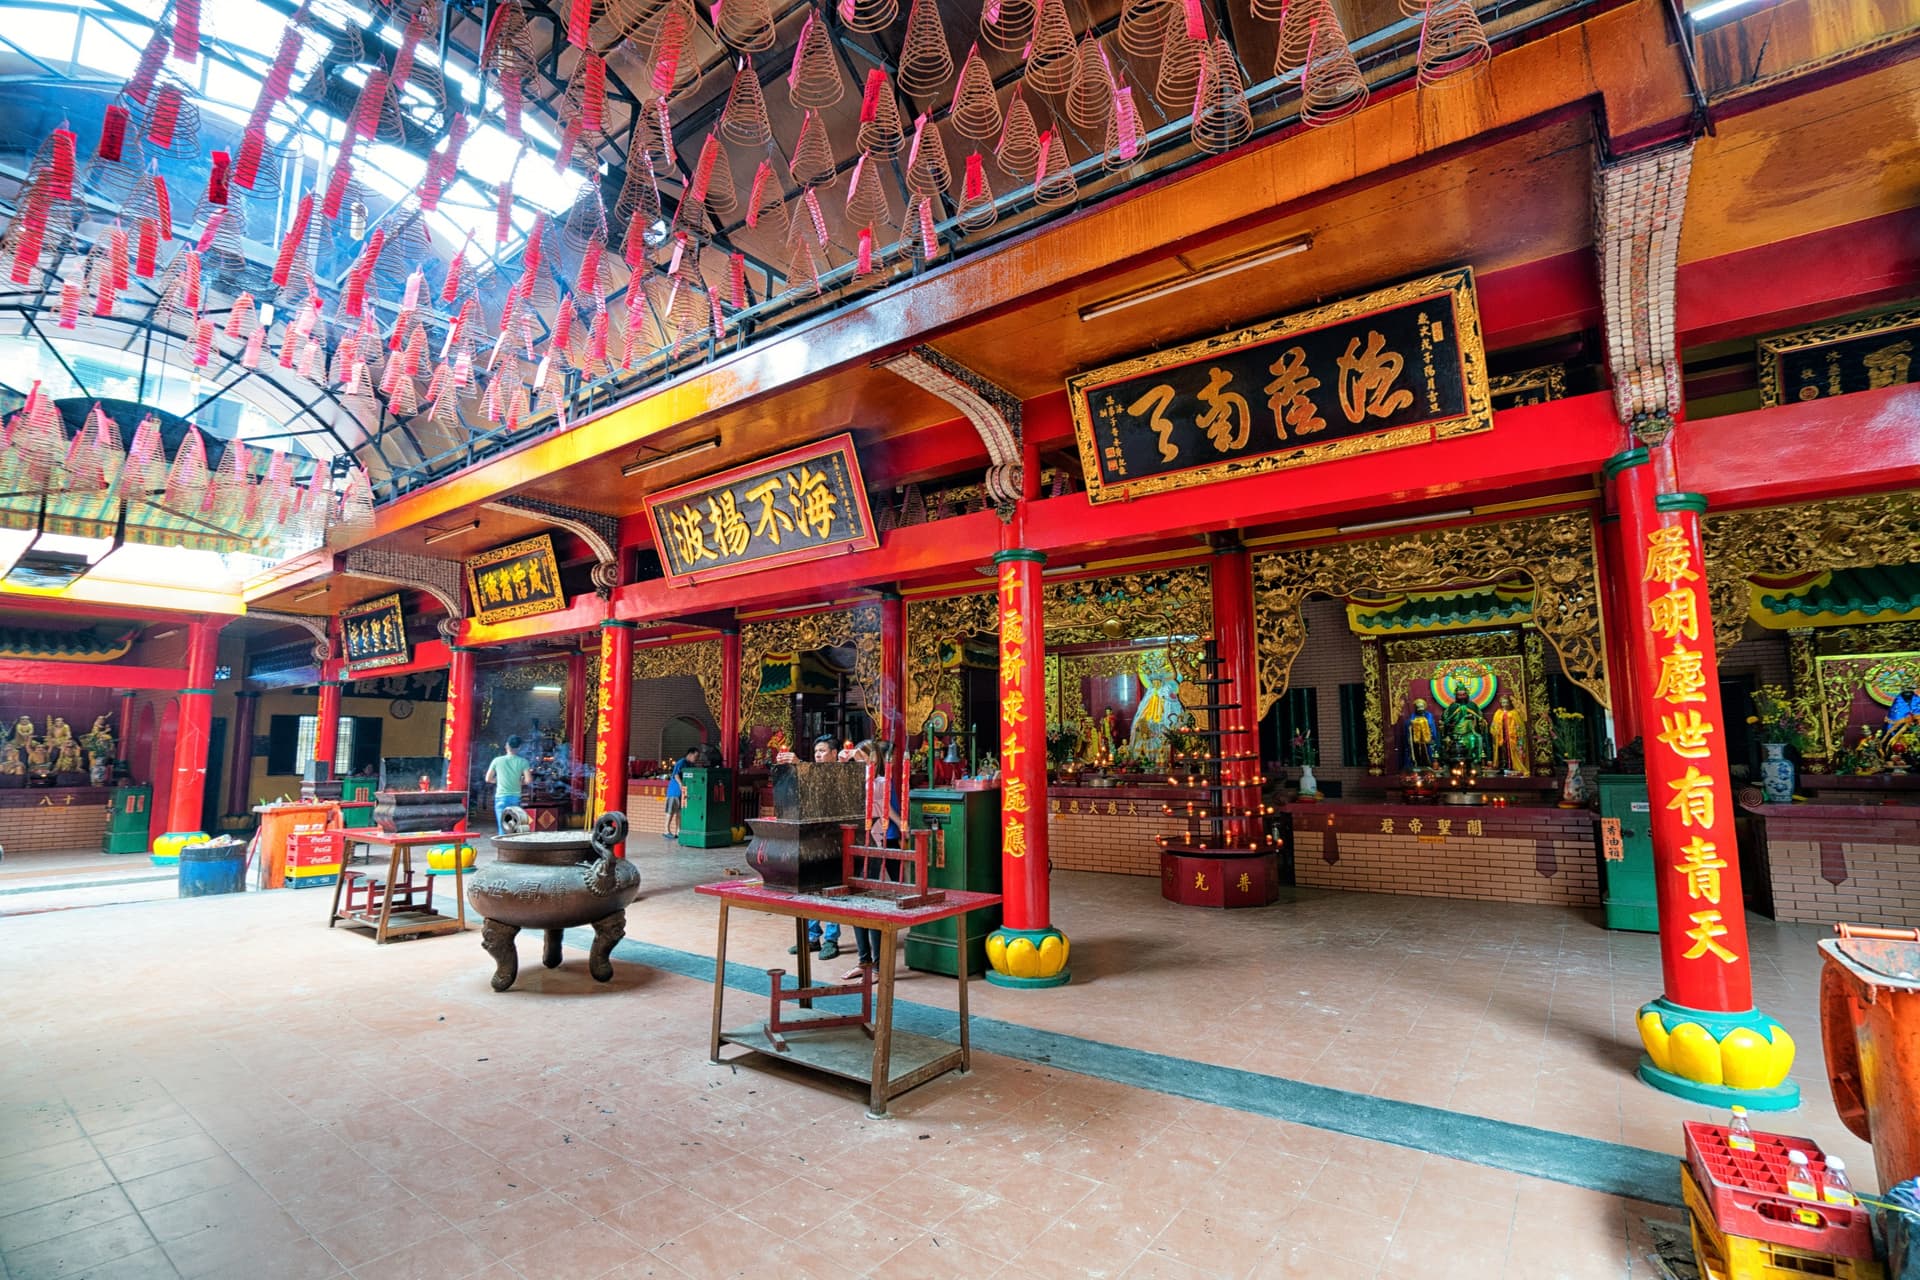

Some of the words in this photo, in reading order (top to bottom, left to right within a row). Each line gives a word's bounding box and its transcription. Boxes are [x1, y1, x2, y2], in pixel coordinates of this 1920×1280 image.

[1642, 525, 1740, 965] 嚴明塵世有青天
